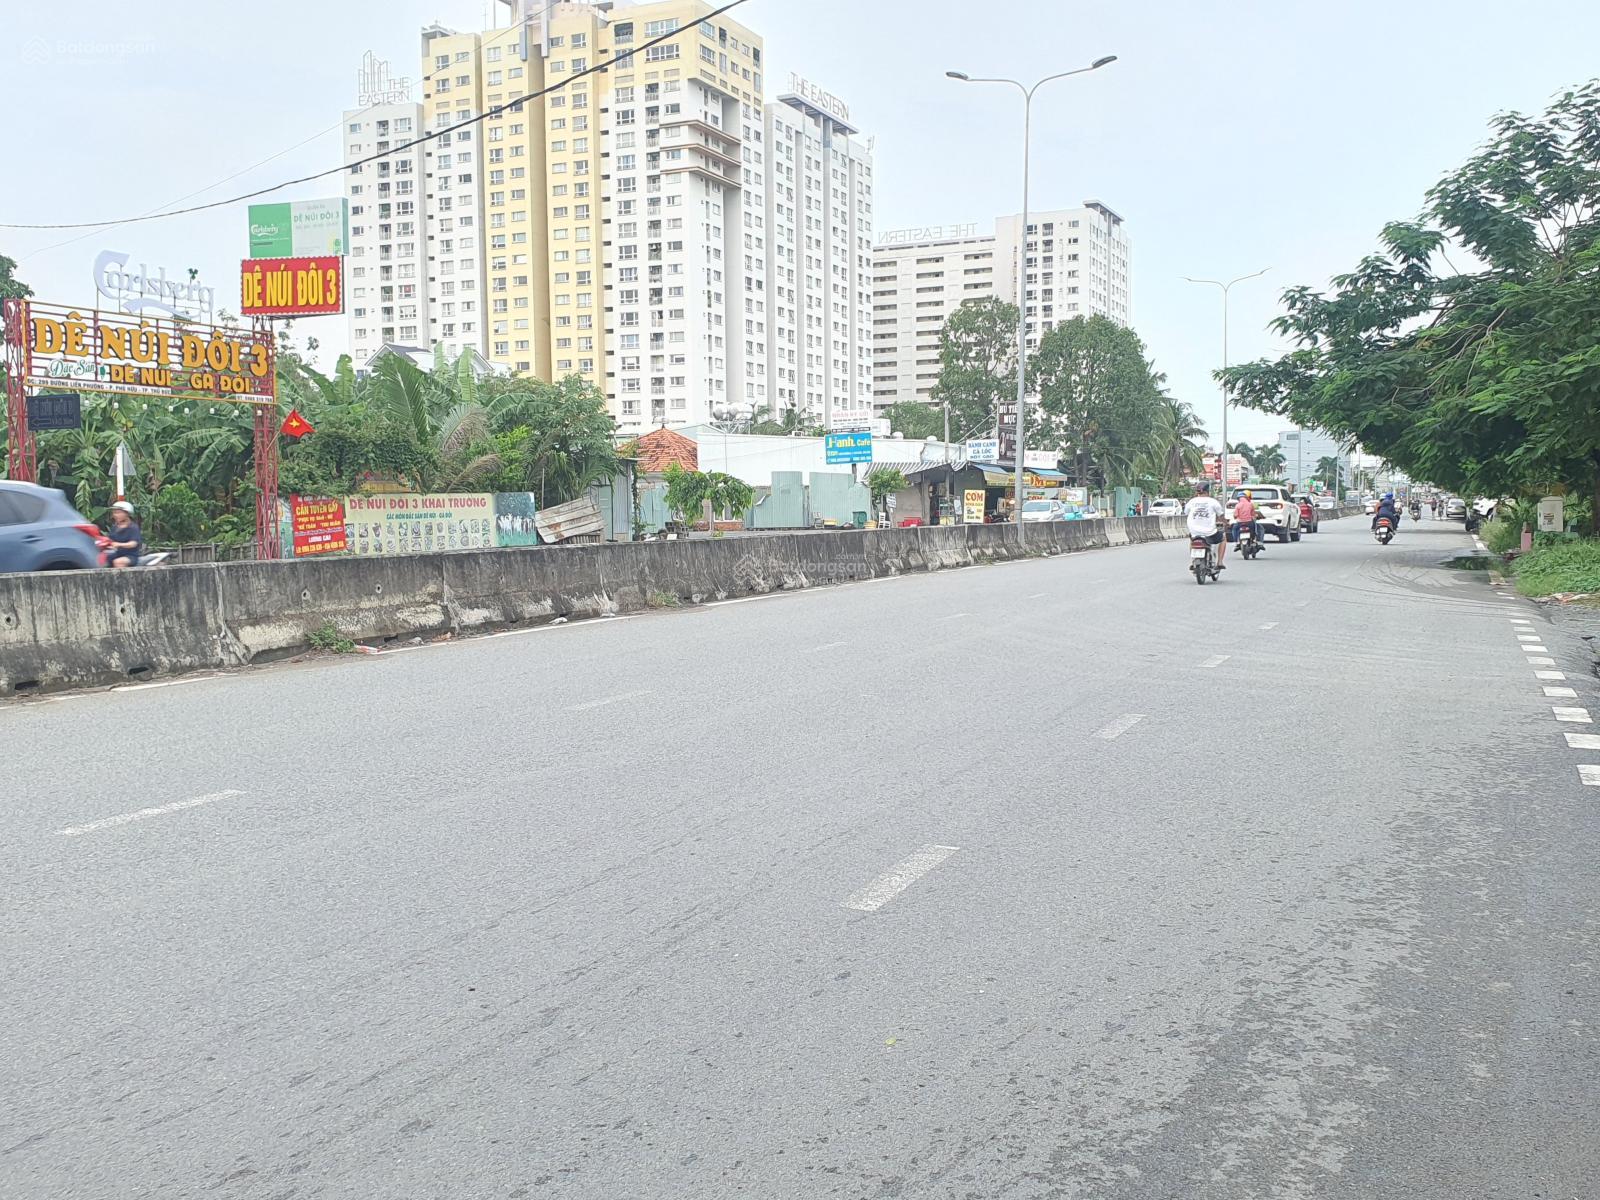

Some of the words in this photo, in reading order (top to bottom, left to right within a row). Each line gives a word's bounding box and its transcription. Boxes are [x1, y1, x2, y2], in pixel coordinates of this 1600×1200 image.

[359, 91, 410, 106] EASTERN
[387, 77, 410, 90] THE
[791, 71, 809, 98] THE
[811, 83, 850, 120] EASTERN
[94, 250, 214, 313] Carlsberg
[242, 265, 263, 308] DÊ
[266, 263, 293, 307] NÚI
[297, 262, 324, 306] ĐÔI
[326, 269, 337, 305] 3
[33, 311, 89, 357] DÊ
[182, 330, 242, 372] ĐÔI
[250, 344, 268, 377] 3
[412, 499, 418, 509] 3
